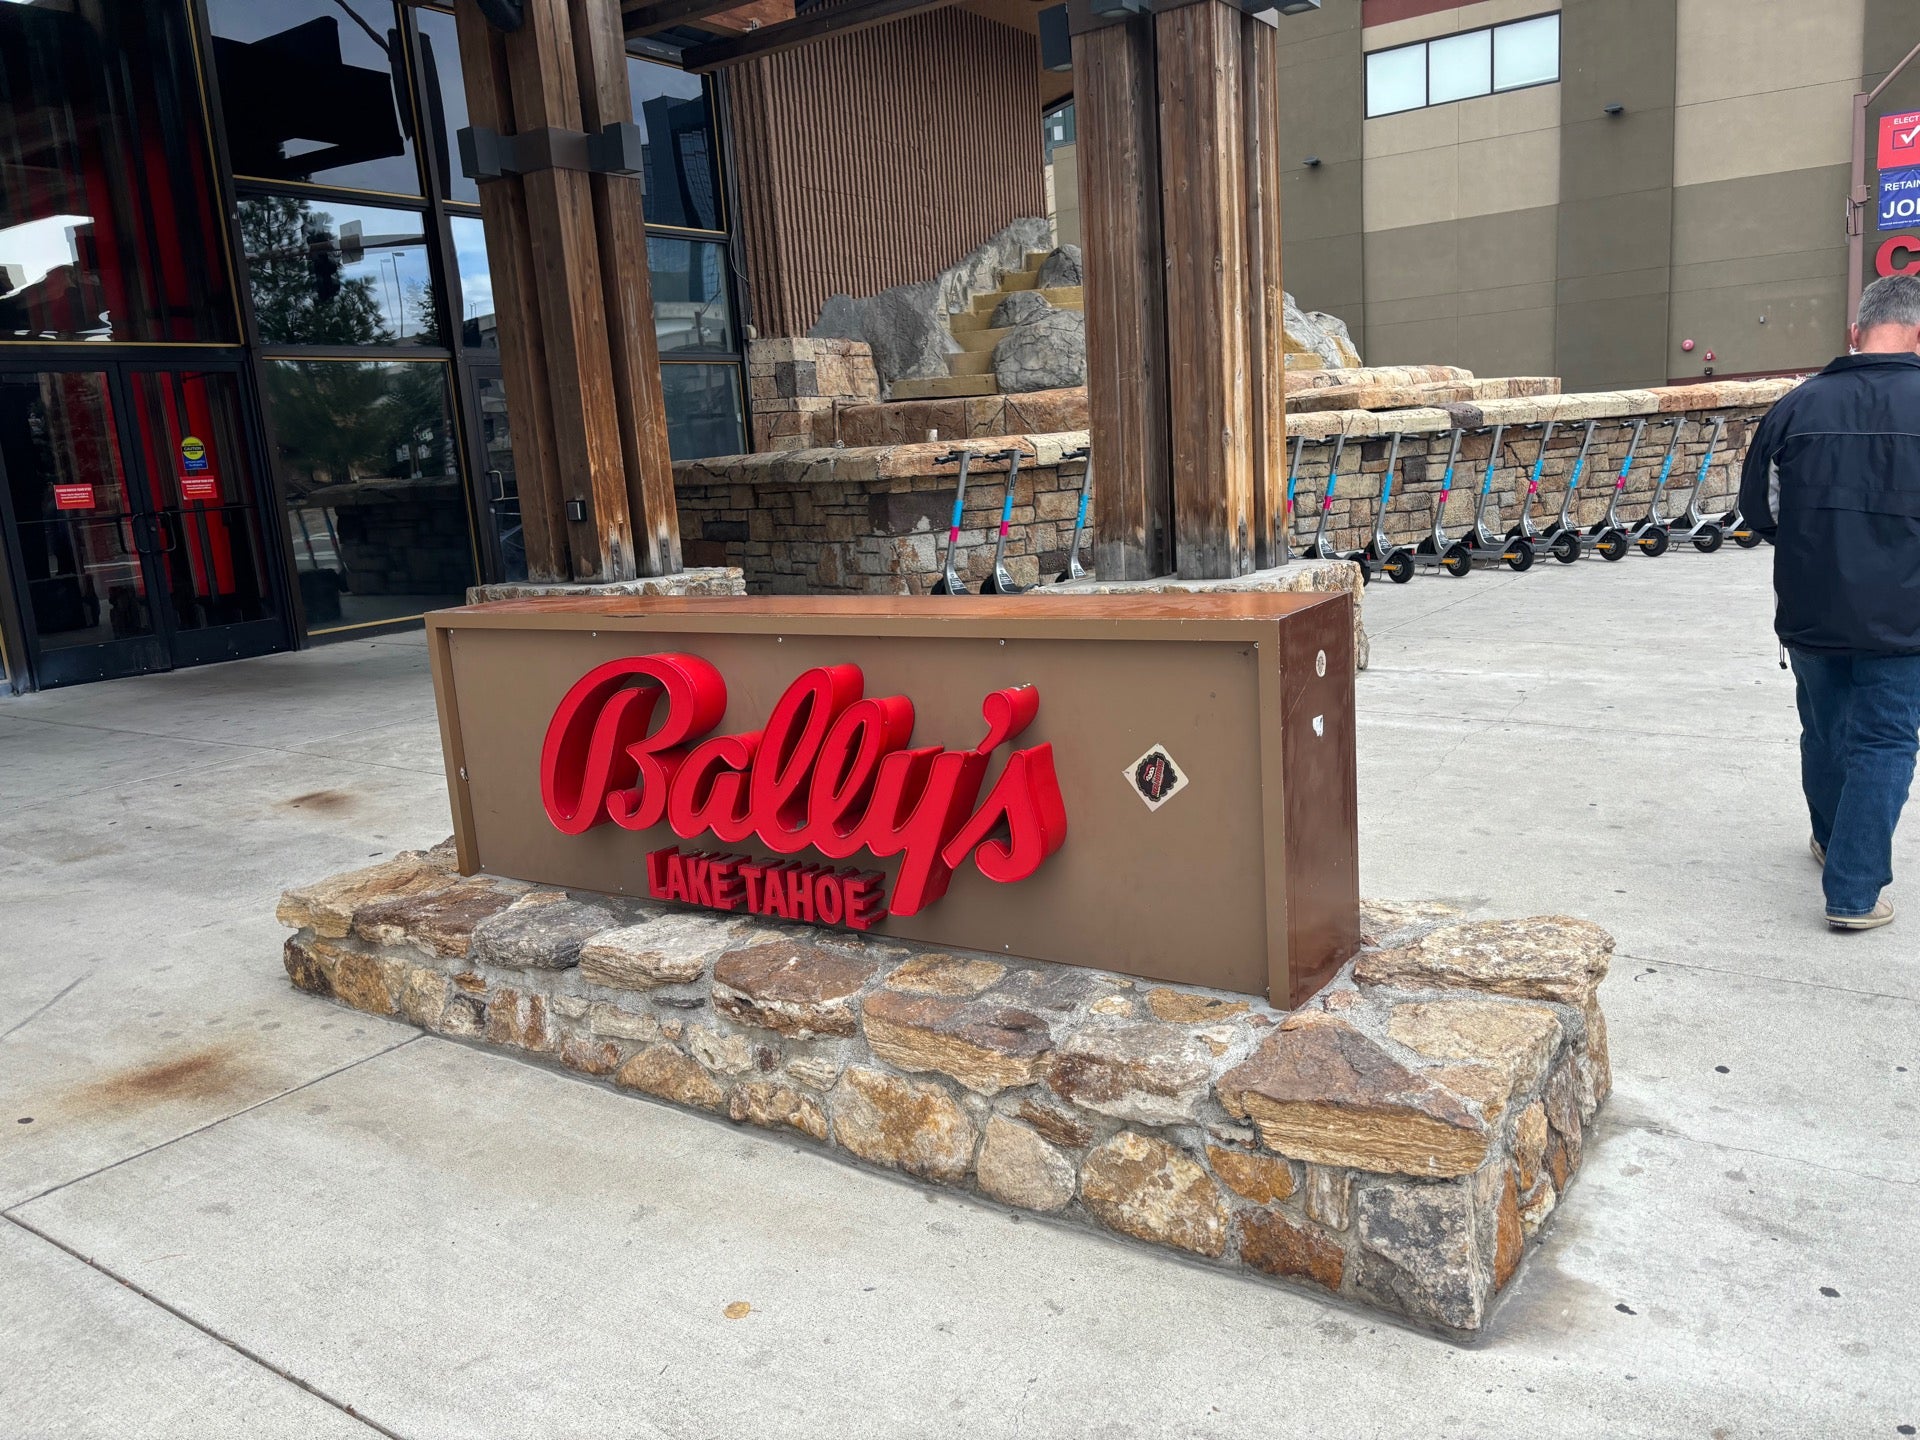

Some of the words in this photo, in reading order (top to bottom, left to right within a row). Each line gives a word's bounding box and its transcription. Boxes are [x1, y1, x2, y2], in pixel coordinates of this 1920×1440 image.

[1893, 115, 1919, 125] ELECT
[540, 652, 1067, 916] Bally's
[646, 847, 749, 910] LAKE
[738, 858, 886, 931] TAHOE
